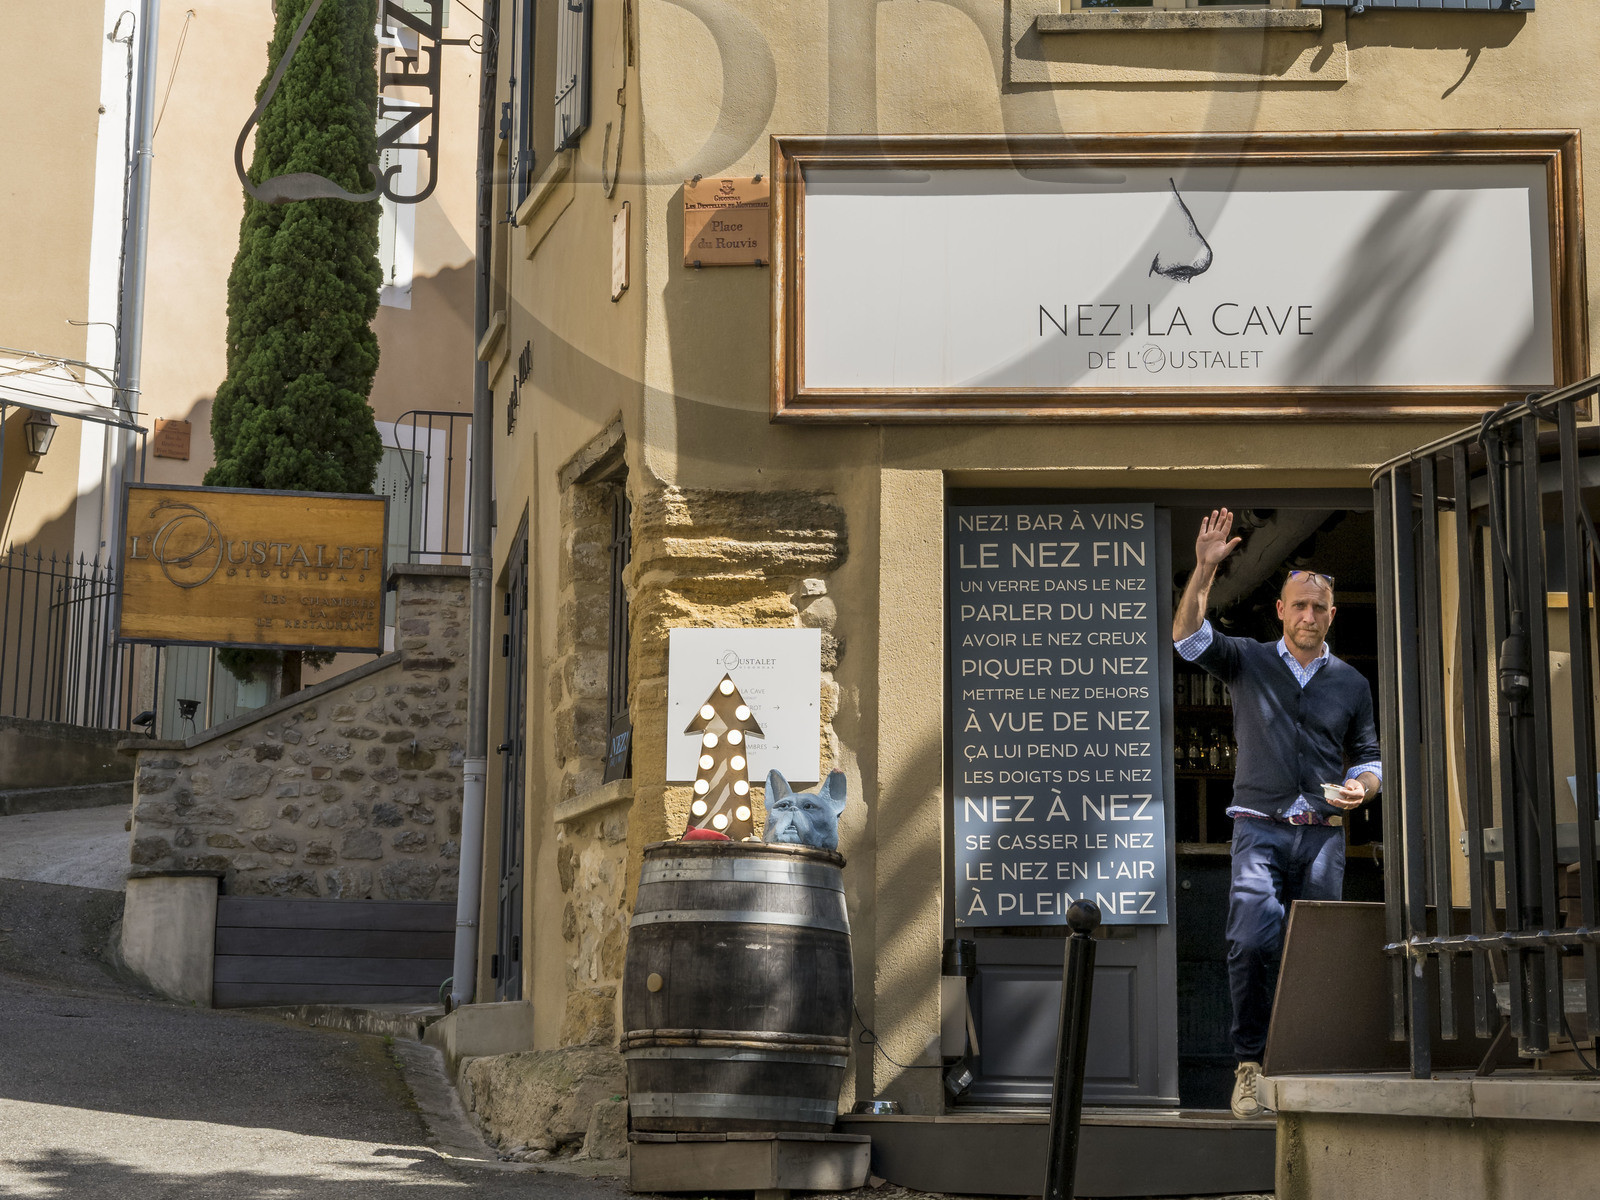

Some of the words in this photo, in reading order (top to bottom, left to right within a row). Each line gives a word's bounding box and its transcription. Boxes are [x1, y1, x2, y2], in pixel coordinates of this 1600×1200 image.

[711, 220, 743, 232] Place
[697, 238, 713, 249] du
[715, 237, 758, 249] Rouvis
[1212, 302, 1313, 336] CAVE
[1088, 351, 1116, 369] DE
[959, 515, 1008, 532] NEZ!
[1017, 514, 1062, 531] BAR
[1070, 509, 1085, 530] À
[1091, 513, 1144, 530] VINS
[960, 543, 999, 568] LE
[1012, 542, 1080, 567] NEZ
[1093, 542, 1145, 567] FIN
[961, 581, 982, 592] UN
[987, 580, 1039, 592] VERRE
[1045, 579, 1087, 591] DANS
[1093, 579, 1110, 591] LE
[1116, 579, 1146, 590] NEZ
[263, 594, 287, 604] LES
[300, 596, 375, 608] CHAMBRES
[309, 608, 327, 618] LA
[339, 611, 375, 620] CAVE
[961, 604, 1052, 621] PARLER
[1061, 603, 1093, 620] DU
[1102, 603, 1147, 620] NEZ
[255, 617, 273, 627] LE
[285, 619, 375, 631] RESTAURANT
[962, 634, 1016, 647] AVOIR
[1023, 633, 1042, 646] LE
[1048, 633, 1082, 646] NEZ
[1088, 632, 1147, 645] CREUX
[962, 658, 1052, 679] PIQUER
[1061, 658, 1093, 675] DU
[1103, 657, 1148, 675] NEZ
[750, 687, 766, 695] CAVE
[963, 688, 1024, 700] METTRE
[1029, 688, 1046, 699] LE
[1051, 688, 1080, 699] NEZ
[1085, 687, 1149, 699] DEHORS
[963, 707, 982, 732] À
[989, 712, 1044, 732] VUE
[1053, 711, 1088, 731] DE
[1098, 711, 1150, 731] NEZ
[964, 745, 988, 762] ÇA
[995, 744, 1021, 758] LUI
[1028, 744, 1078, 758] PEND
[1084, 744, 1108, 757] AU
[1115, 743, 1150, 757] NEZ
[964, 771, 994, 783] LES
[1000, 770, 1062, 783] DOIGTS
[1068, 770, 1090, 782] DS
[1096, 770, 1114, 782] LE
[1120, 769, 1151, 782] NEZ
[965, 796, 1034, 822] NEZ
[1046, 788, 1070, 821] À
[1083, 794, 1154, 821] NEZ
[966, 835, 991, 850] SE
[998, 834, 1077, 850] CASSER
[1085, 834, 1108, 849] LE
[1115, 833, 1154, 849] NEZ
[966, 863, 993, 880] LE
[1002, 862, 1048, 880] NEZ
[1057, 862, 1088, 879] EN
[1097, 861, 1155, 879] L'AIR
[968, 887, 988, 915] À
[998, 892, 1084, 915] PLEIN
[1096, 892, 1156, 914] NEZ
